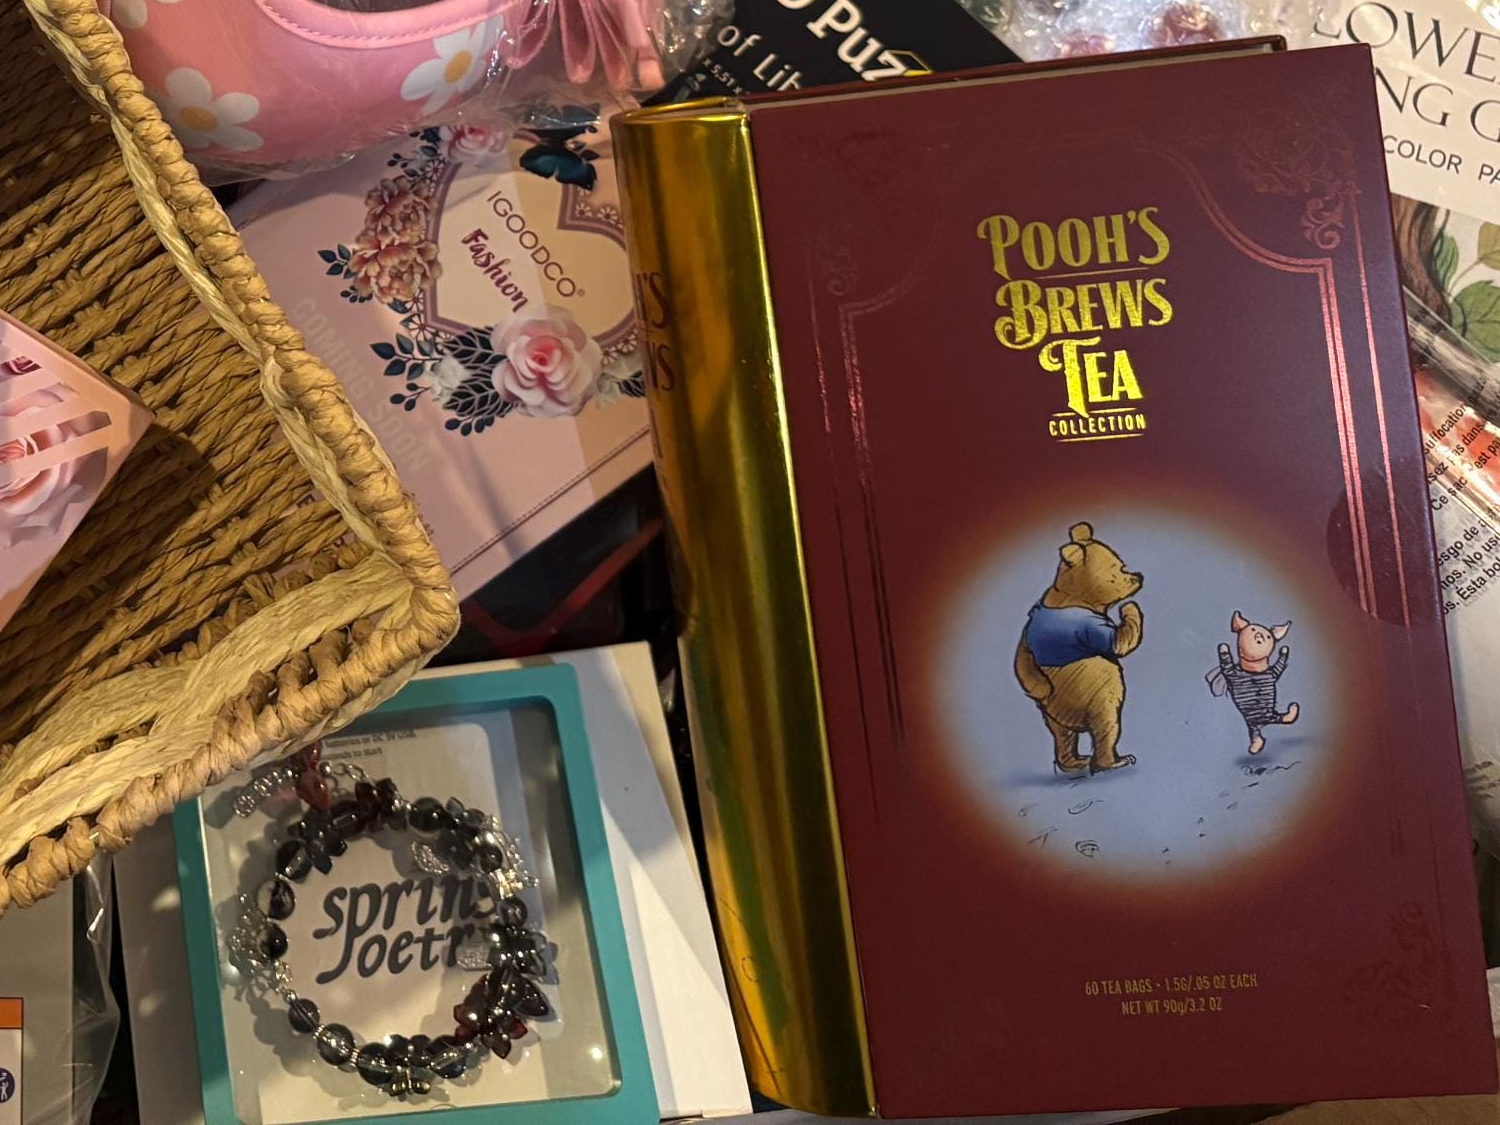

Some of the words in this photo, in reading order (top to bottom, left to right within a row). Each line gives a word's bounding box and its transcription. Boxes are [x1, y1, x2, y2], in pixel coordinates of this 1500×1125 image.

[717, 25, 761, 57] of
[1383, 134, 1463, 174] COLOR
[487, 189, 577, 298] IGOODCO
[976, 206, 1170, 280] POOH'S
[461, 226, 529, 314] Fashion
[994, 278, 1173, 350] BREWS
[1038, 335, 1143, 418] TEA
[1049, 414, 1147, 438] COLLECTION
[1462, 421, 1485, 447] dans
[1430, 495, 1449, 511] Ce
[1447, 475, 1468, 496] sac
[1463, 525, 1479, 542] de
[1462, 550, 1483, 568] No
[1085, 981, 1099, 996] 60
[1101, 980, 1122, 996] TEA
[1125, 978, 1153, 994] BAGS
[1213, 974, 1227, 989] OZ
[1229, 973, 1258, 989] EACH
[1121, 1000, 1141, 1016] NET
[1144, 999, 1160, 1015] WT
[1209, 996, 1223, 1011] OZ
